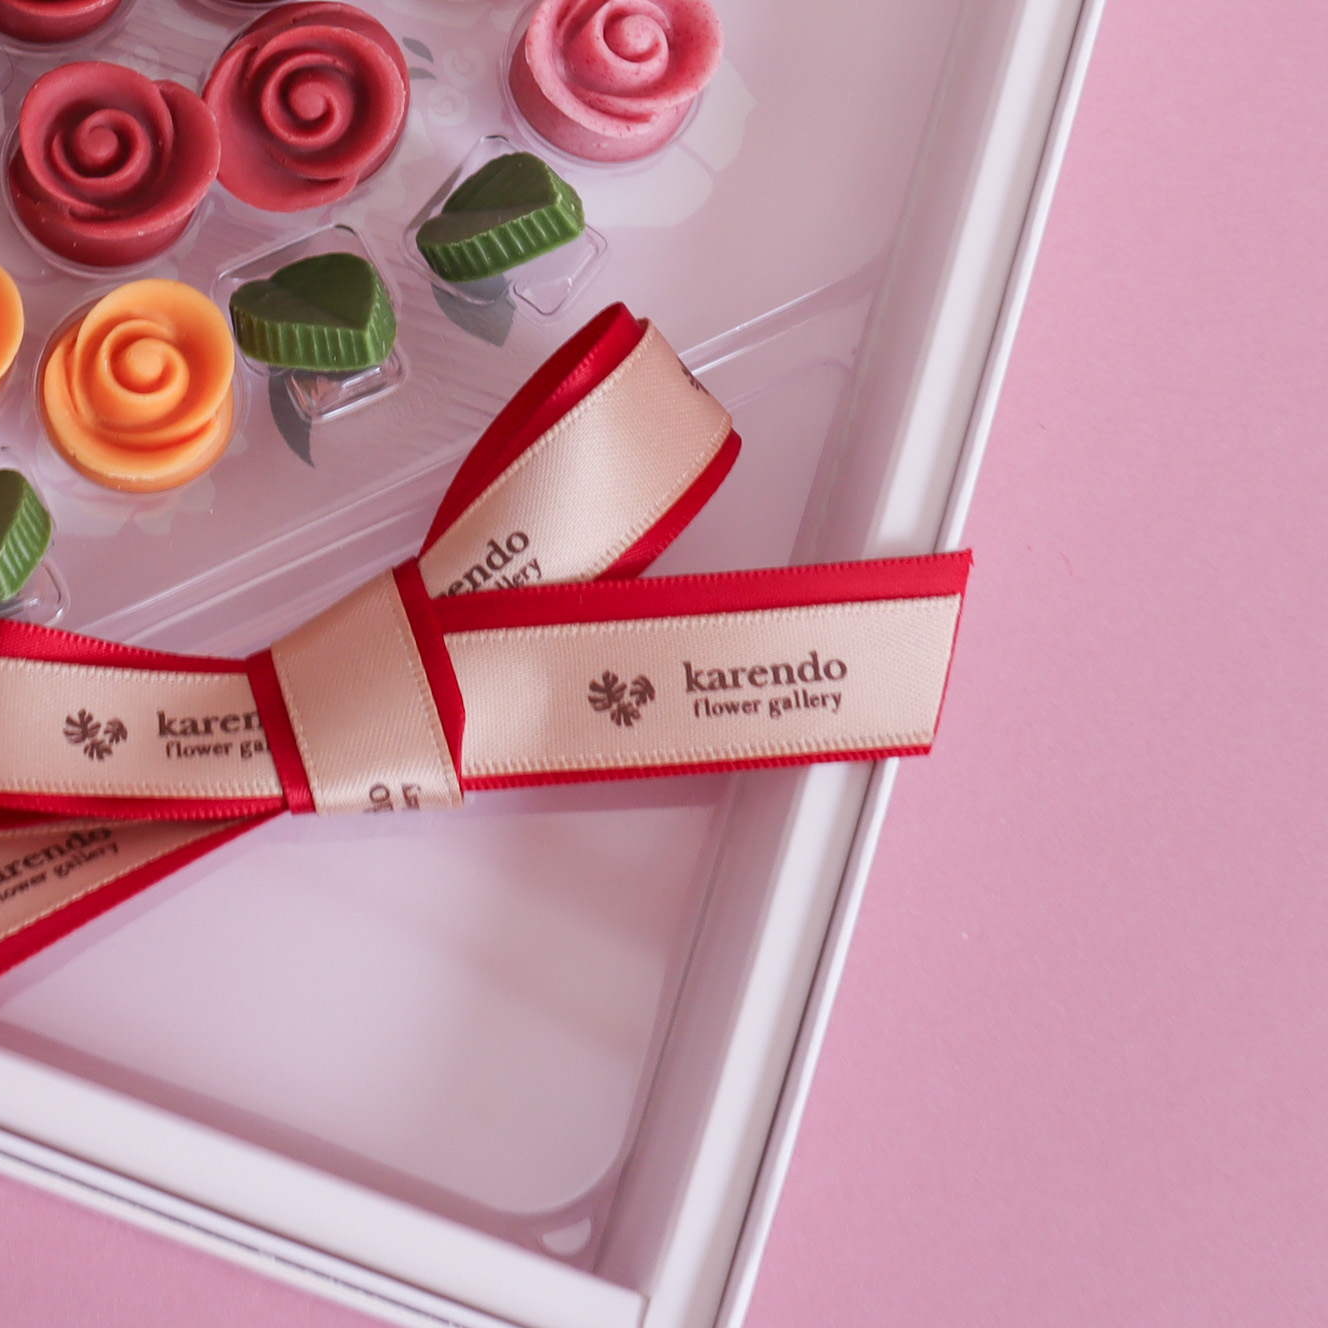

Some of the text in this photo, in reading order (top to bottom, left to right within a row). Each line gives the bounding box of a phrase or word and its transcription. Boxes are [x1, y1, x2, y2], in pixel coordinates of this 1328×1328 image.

[438, 531, 529, 598] endo
[683, 650, 848, 693] karendo
[693, 687, 843, 719] flower gallery
[156, 710, 264, 736] karen
[165, 739, 233, 759] flower
[53, 841, 119, 879] gallery
